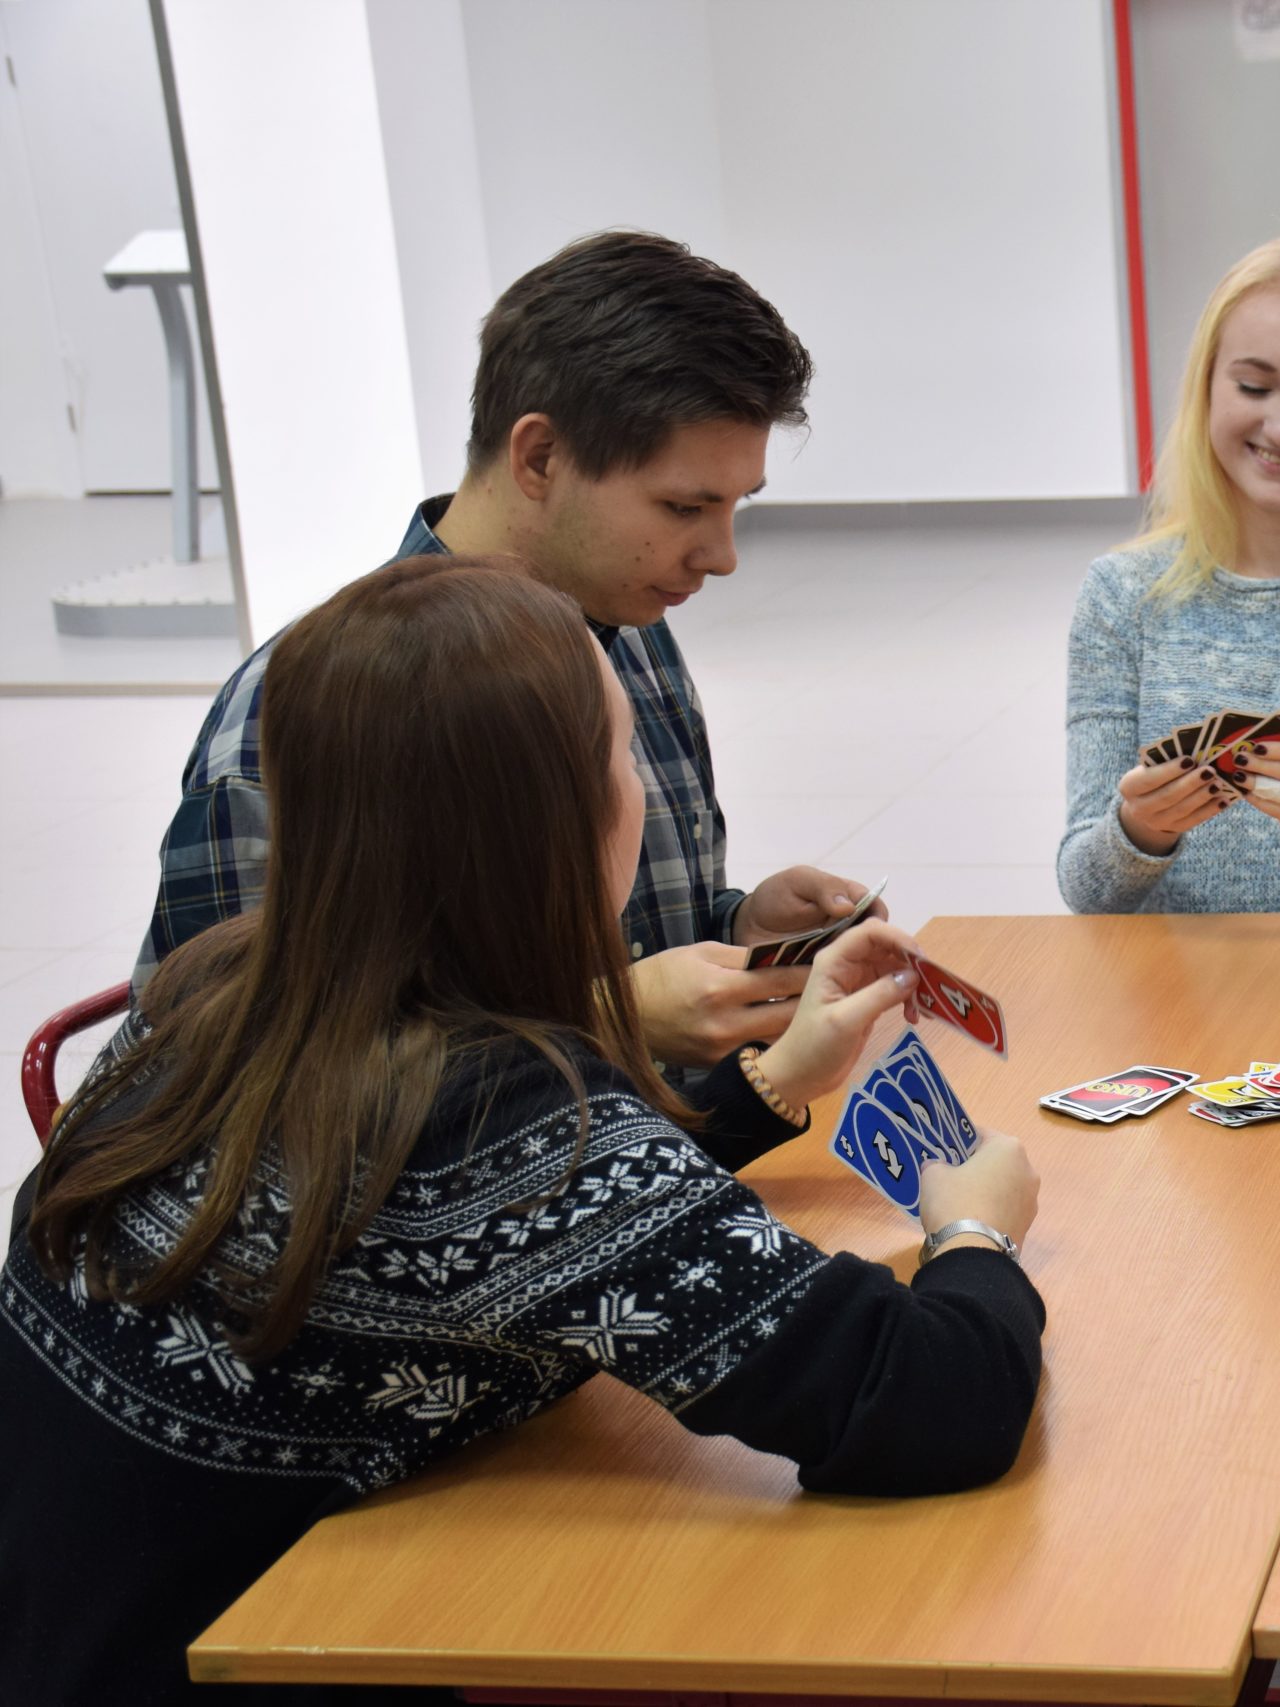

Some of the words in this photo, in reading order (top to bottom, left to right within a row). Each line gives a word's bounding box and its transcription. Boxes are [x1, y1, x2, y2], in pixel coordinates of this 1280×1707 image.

[939, 983, 972, 1020] 4
[1085, 1081, 1153, 1098] UNO
[960, 1118, 974, 1139] 5
